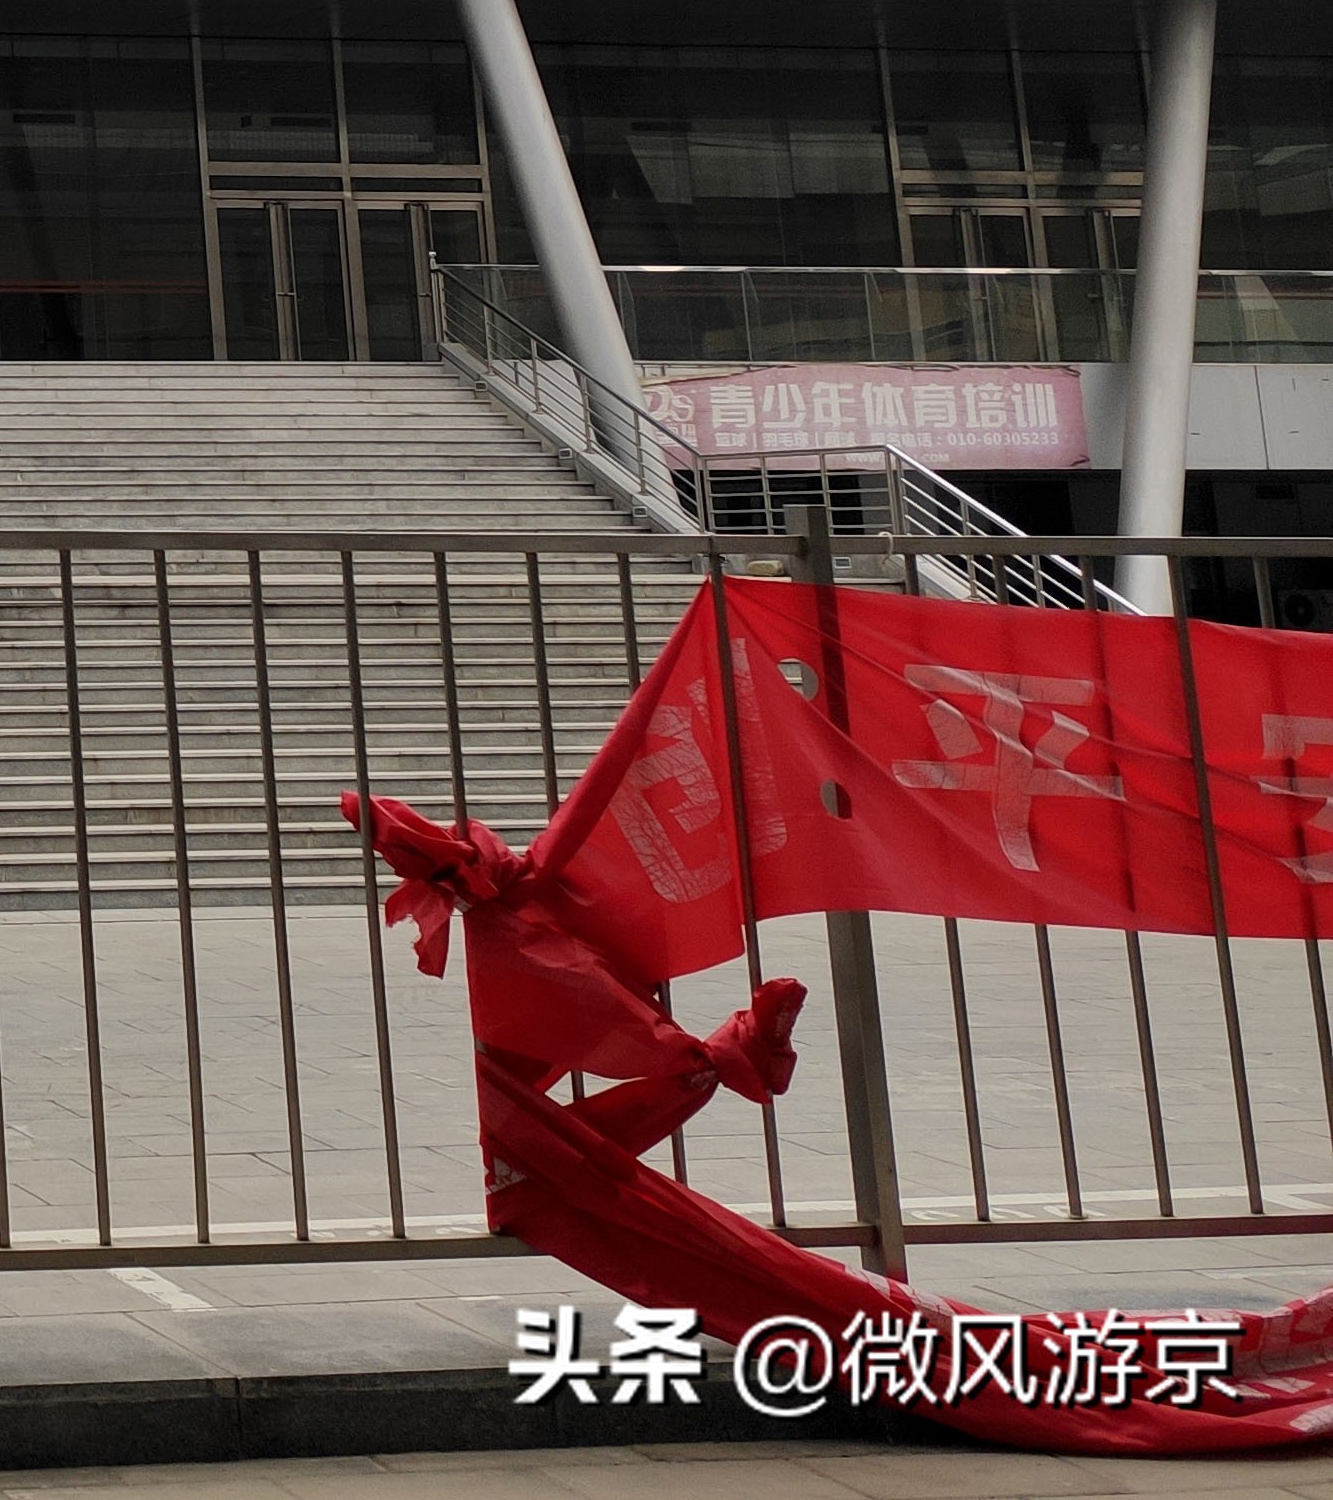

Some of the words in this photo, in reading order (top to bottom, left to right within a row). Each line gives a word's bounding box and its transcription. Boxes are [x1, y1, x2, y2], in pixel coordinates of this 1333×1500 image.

[709, 381, 1059, 430] 青少年体育培训
